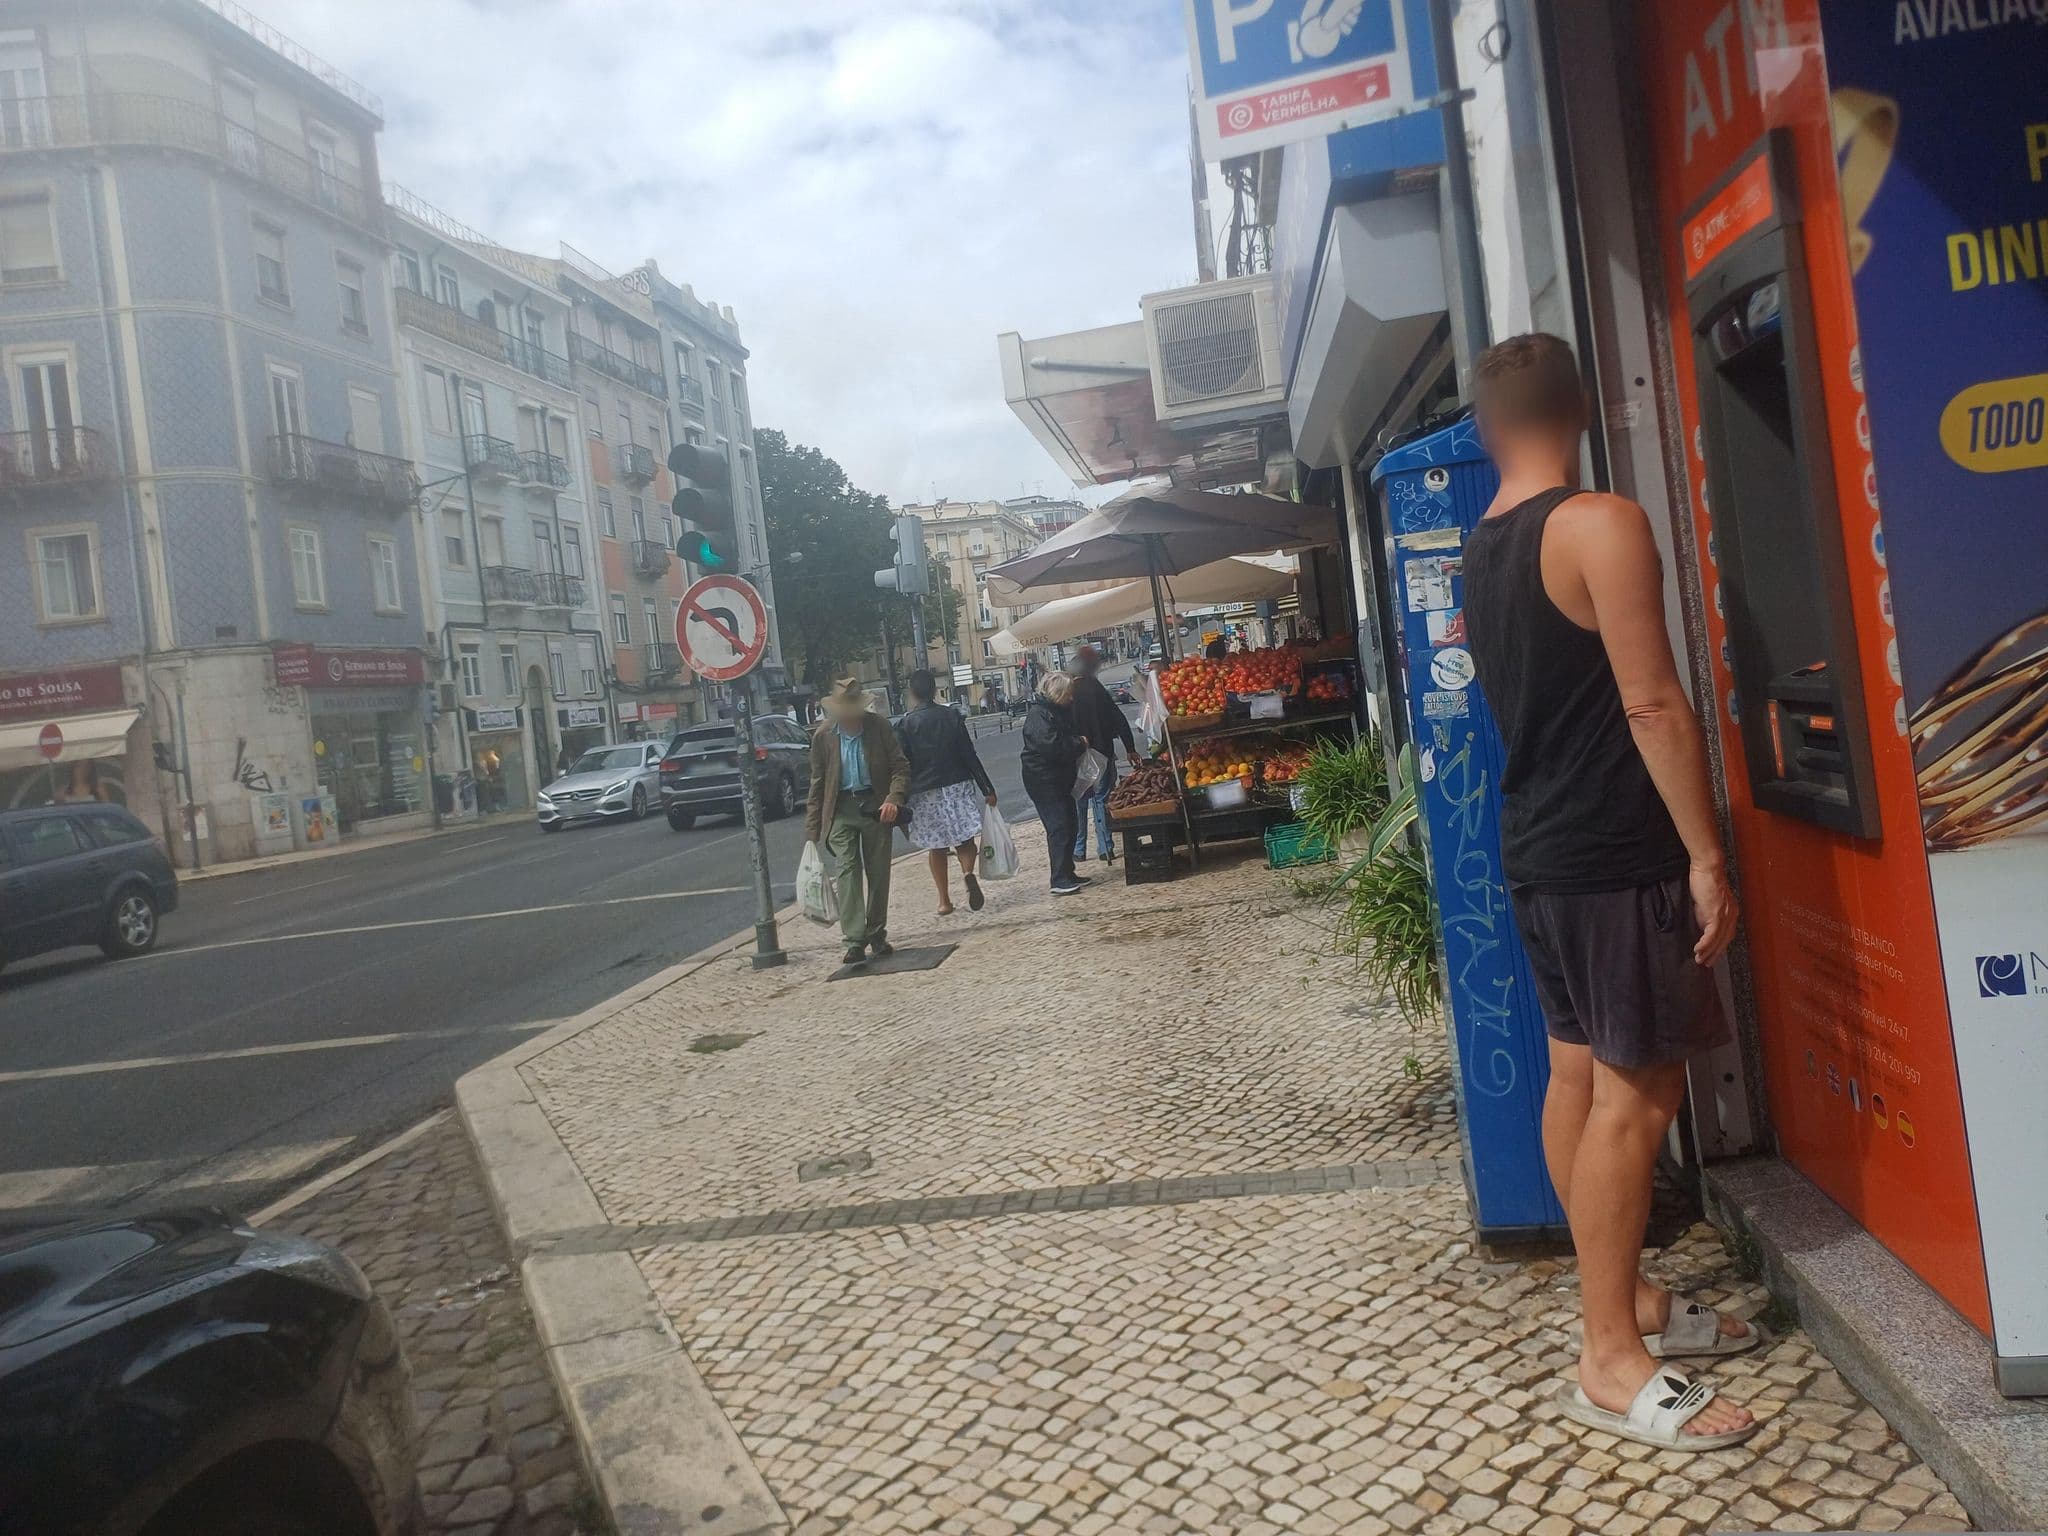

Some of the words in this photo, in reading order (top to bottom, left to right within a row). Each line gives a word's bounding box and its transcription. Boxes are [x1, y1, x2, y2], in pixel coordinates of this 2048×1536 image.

[1212, 0, 1275, 64] P
[1683, 0, 1790, 167] ATM
[1259, 88, 1312, 110] TARIFA
[1262, 96, 1339, 124] VERMELHA
[1967, 397, 2045, 454] TODO
[1020, 634, 1049, 649] SAGRES
[1447, 657, 1465, 670] Free
[17, 687, 33, 698] DE
[39, 681, 82, 696] SOUSA
